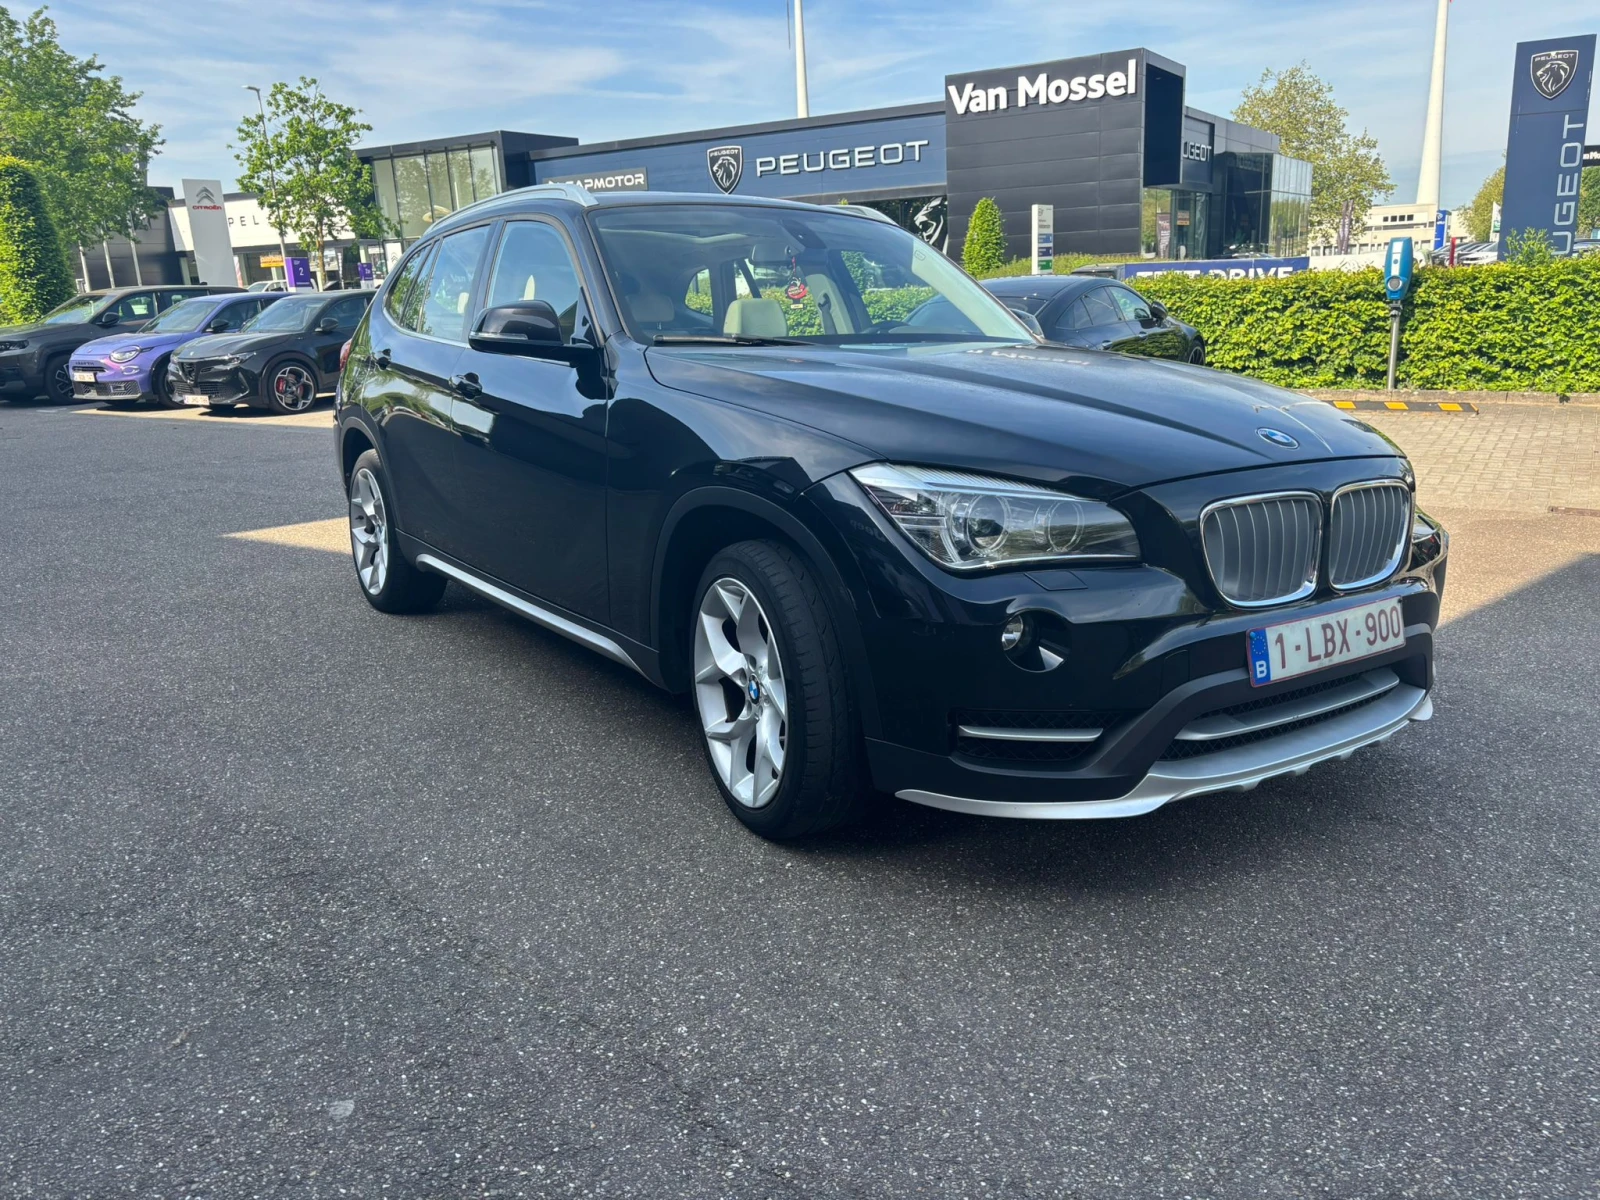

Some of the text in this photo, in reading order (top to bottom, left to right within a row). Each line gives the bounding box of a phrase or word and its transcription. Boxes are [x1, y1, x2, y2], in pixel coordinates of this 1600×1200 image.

[1534, 53, 1575, 61] PEUGEOT
[947, 59, 1137, 115] Van Mossel
[710, 149, 739, 157] PEUGEOT
[756, 139, 929, 177] PEUGEOT
[1182, 141, 1212, 161] UGEOT
[556, 173, 645, 190] APMOTOR
[1551, 114, 1584, 255] UGEOT
[228, 215, 259, 227] PEL
[298, 267, 304, 276] 2
[1275, 605, 1401, 669] 1-LBX-900
[1255, 659, 1268, 679] B
